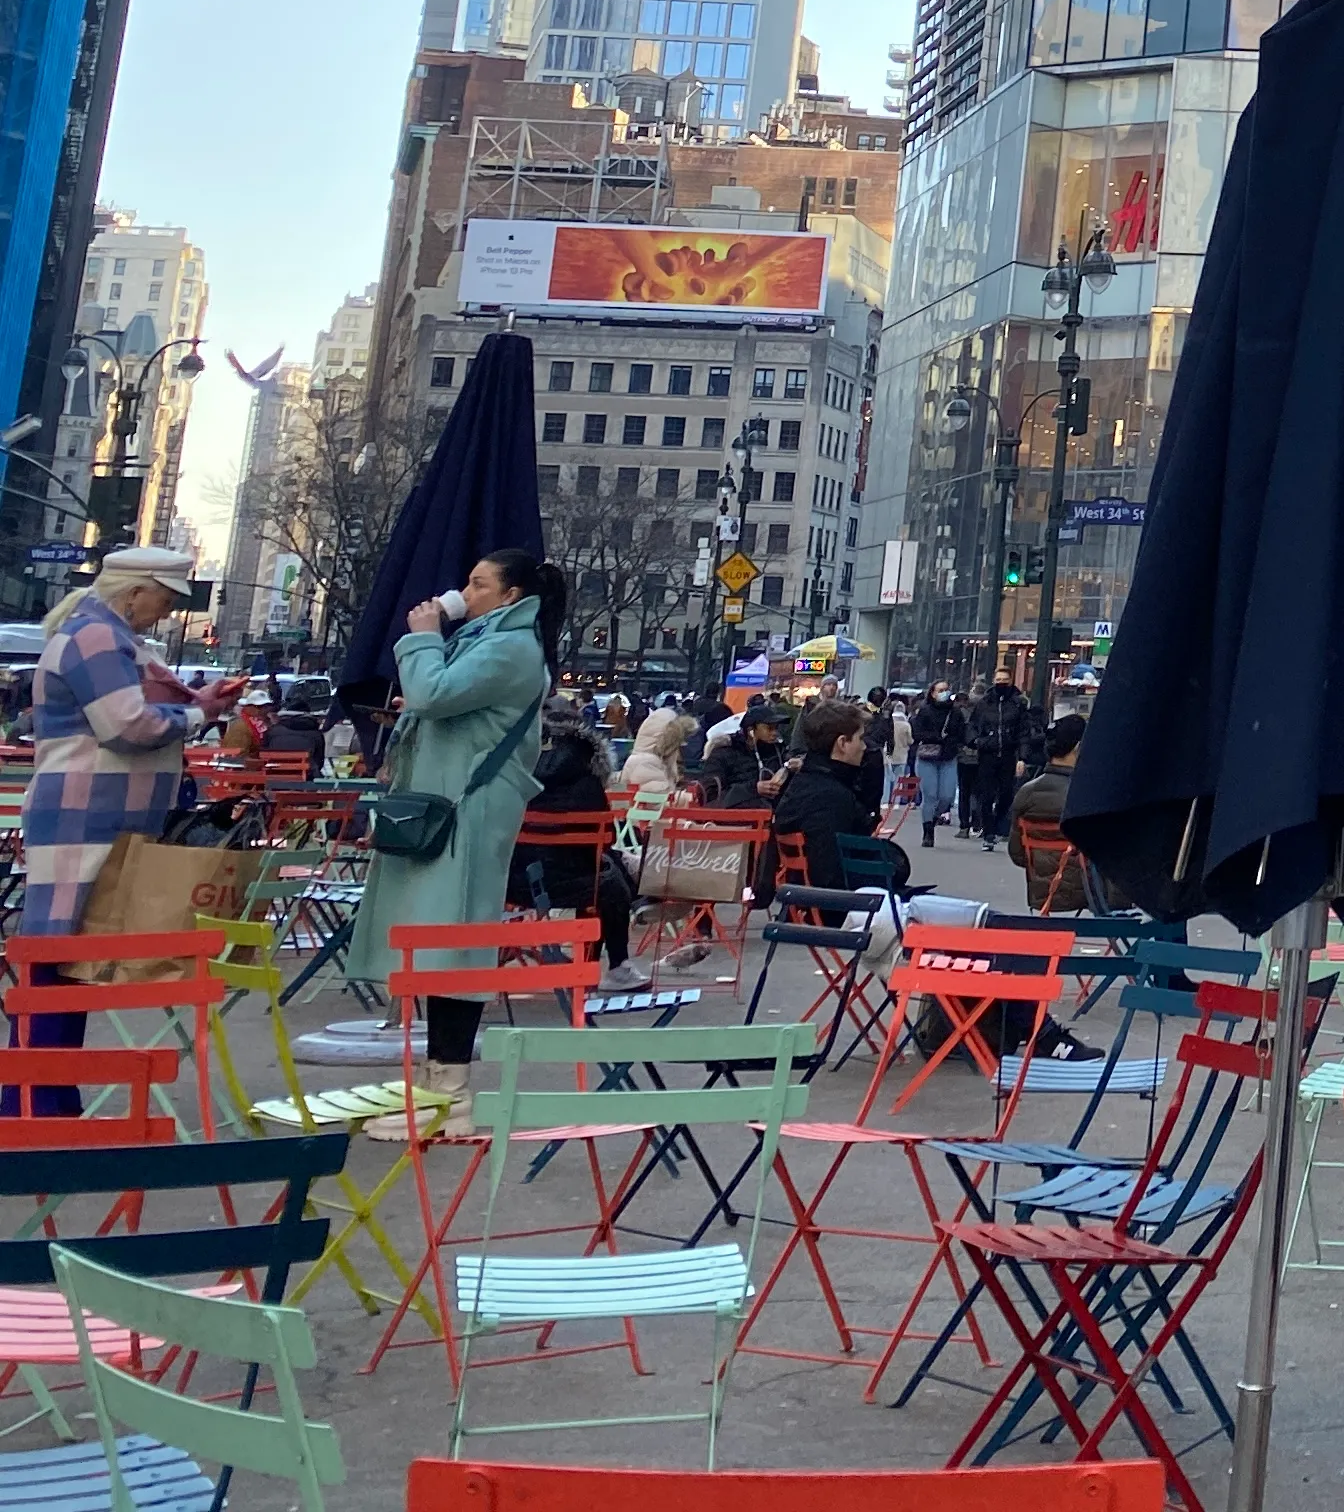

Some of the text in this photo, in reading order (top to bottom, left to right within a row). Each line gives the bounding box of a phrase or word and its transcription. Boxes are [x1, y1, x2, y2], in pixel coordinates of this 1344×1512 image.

[1074, 507, 1144, 521] West 34th St
[723, 571, 750, 580] SLOW
